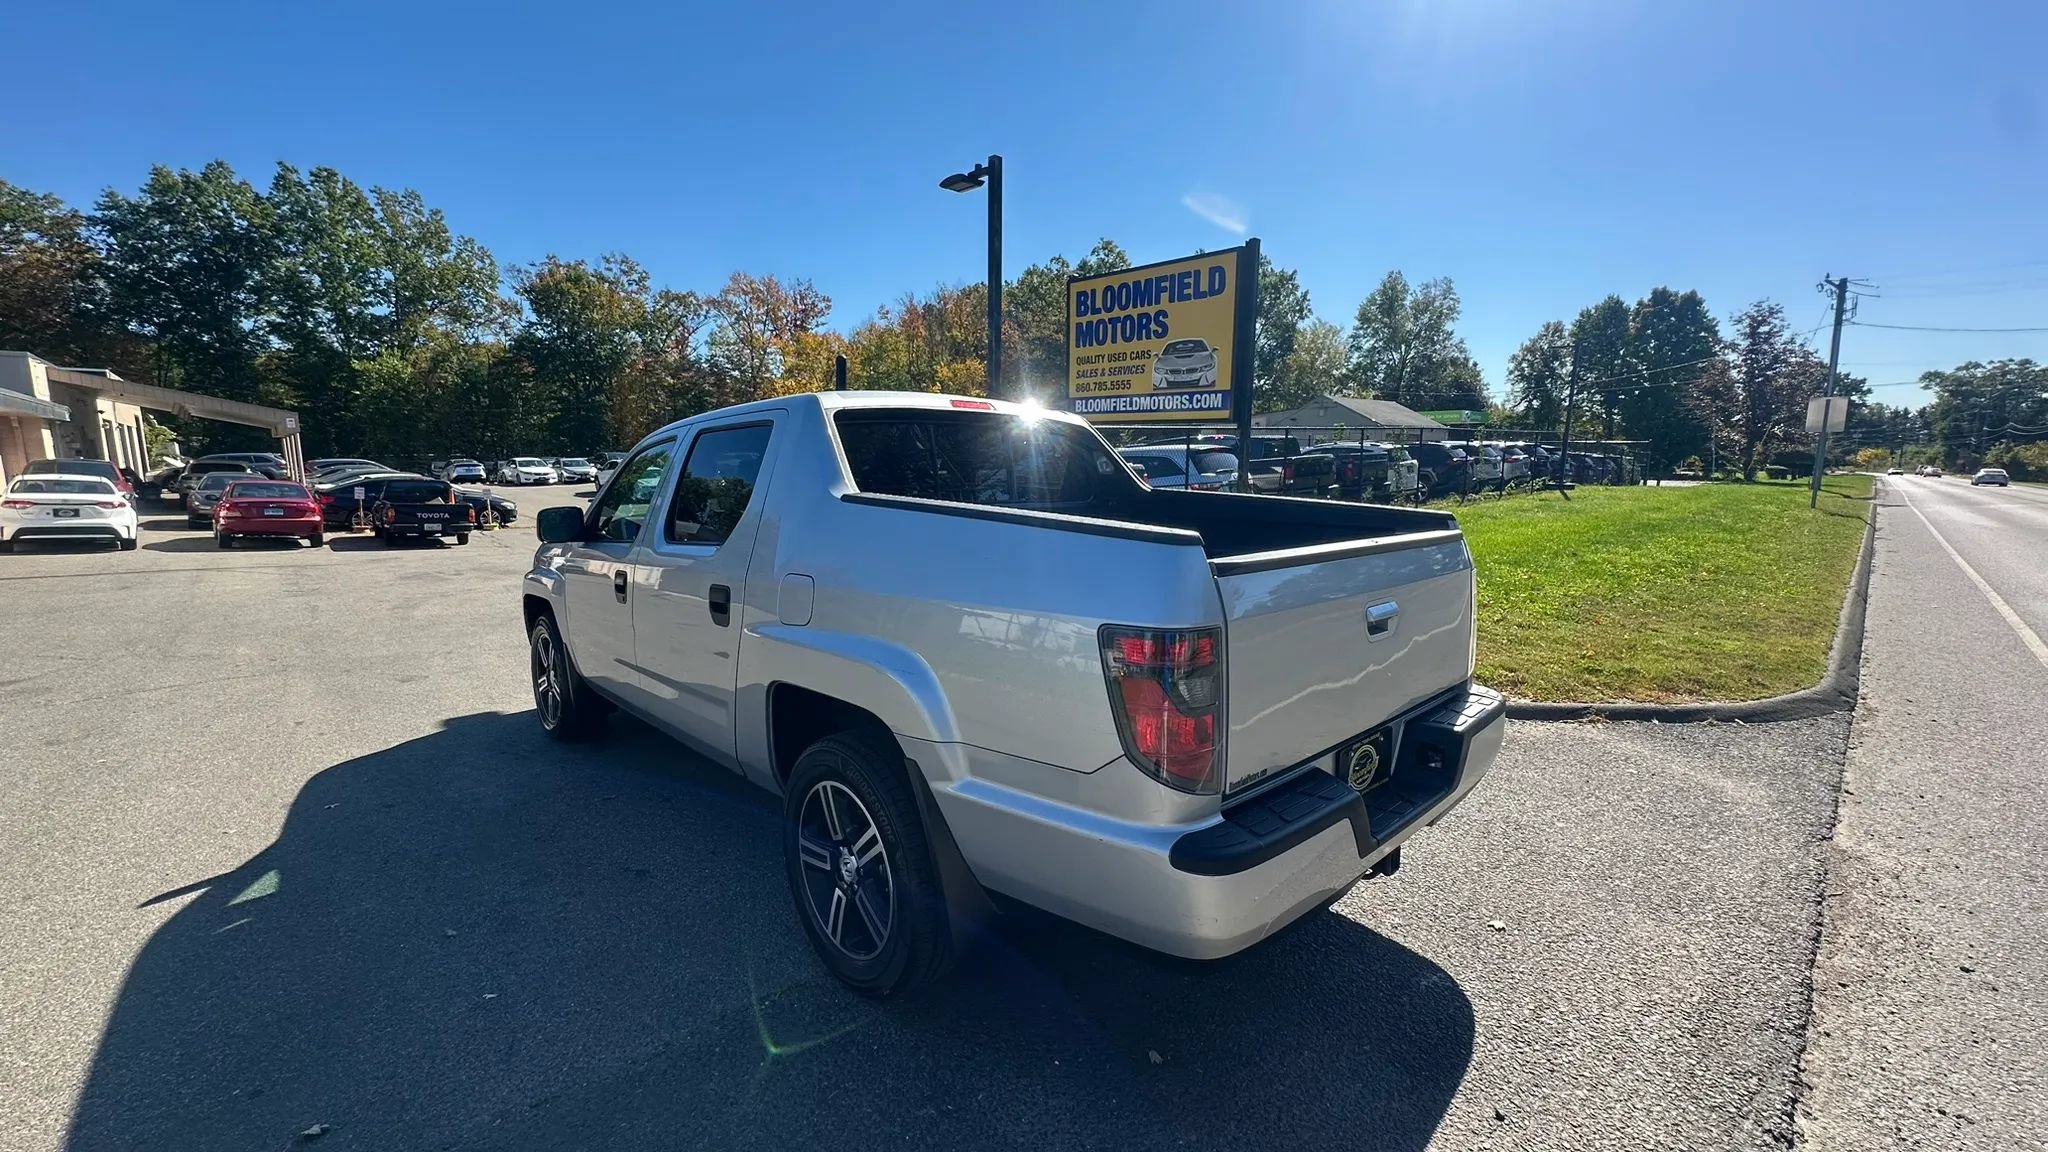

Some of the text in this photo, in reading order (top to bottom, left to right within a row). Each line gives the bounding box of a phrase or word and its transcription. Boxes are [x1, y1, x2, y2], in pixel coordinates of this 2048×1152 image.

[1075, 266, 1226, 317] BLOOMFIELD
[1075, 309, 1169, 348] MOTORS
[1076, 350, 1152, 366] QUALITY USED CARS
[1075, 364, 1146, 379] SALES & SERVICES
[1075, 379, 1132, 393] 860.785.5555
[1075, 393, 1222, 412] BLOOMFIELDMOTORS.COM
